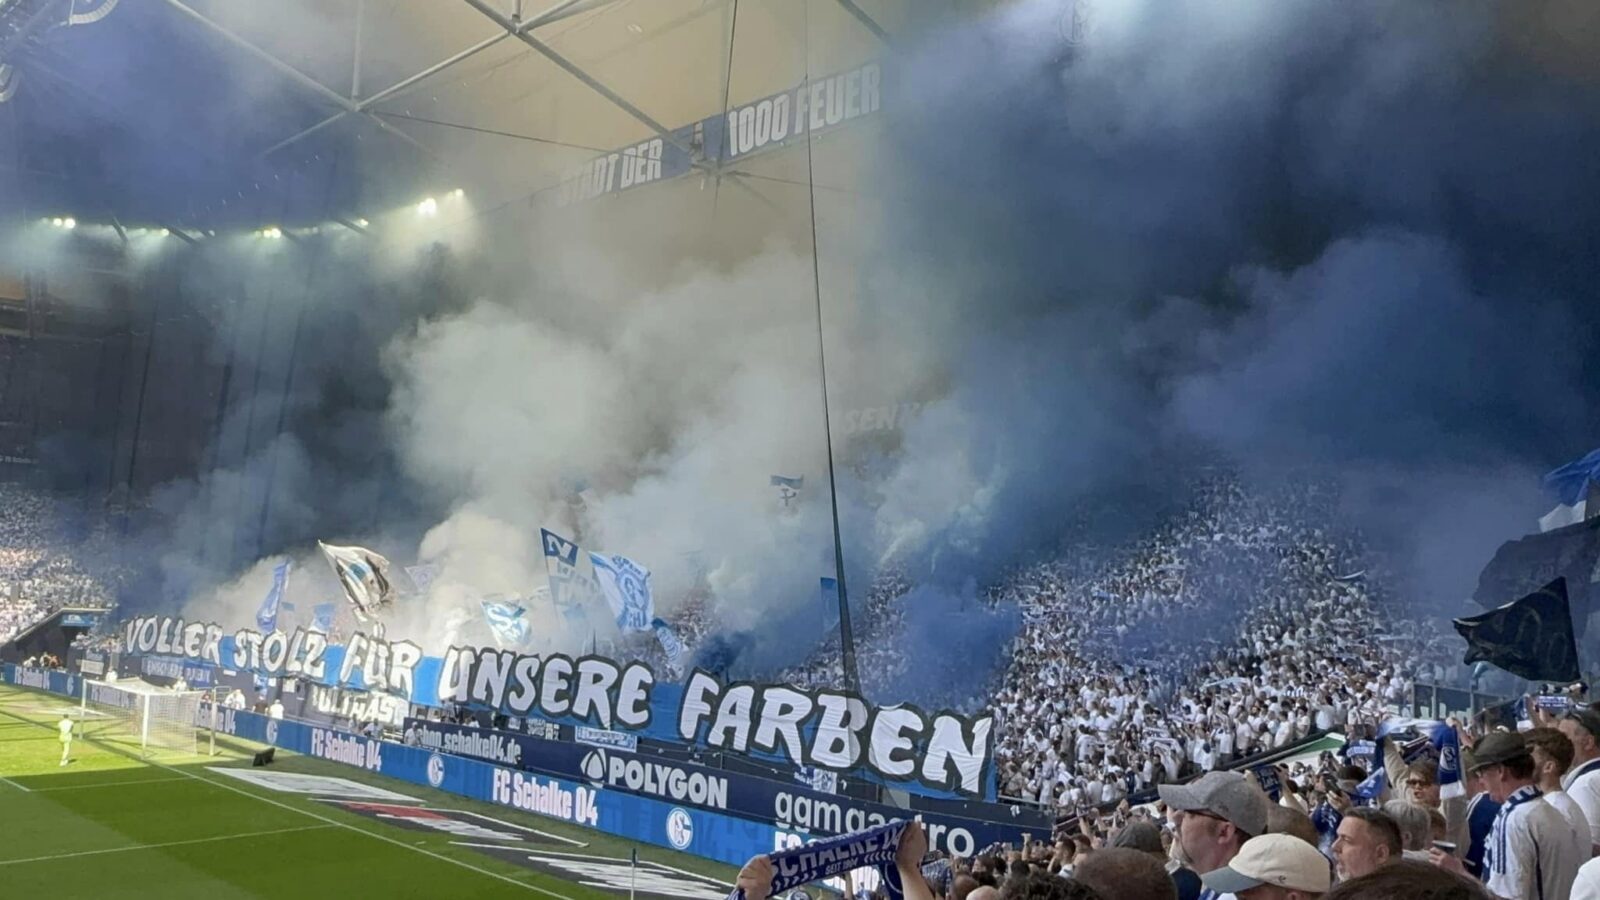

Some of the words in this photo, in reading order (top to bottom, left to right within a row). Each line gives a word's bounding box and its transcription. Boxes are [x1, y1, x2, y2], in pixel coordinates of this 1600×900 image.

[728, 94, 789, 156] 1000
[794, 63, 881, 135] FEUER
[620, 139, 663, 188] DER
[126, 616, 223, 667] VOLLER
[233, 626, 328, 679] STOLZ
[339, 622, 422, 702] FÜR
[437, 647, 653, 730] UNSERE
[679, 672, 993, 793] FARBEN
[311, 728, 324, 757] FC
[325, 731, 365, 767] Schalke
[366, 740, 382, 771] 04
[493, 768, 511, 802] FC
[513, 772, 573, 819] Schalke
[575, 786, 599, 826] 04
[608, 756, 728, 809] POLYGON
[774, 791, 975, 857] ggmgaro
